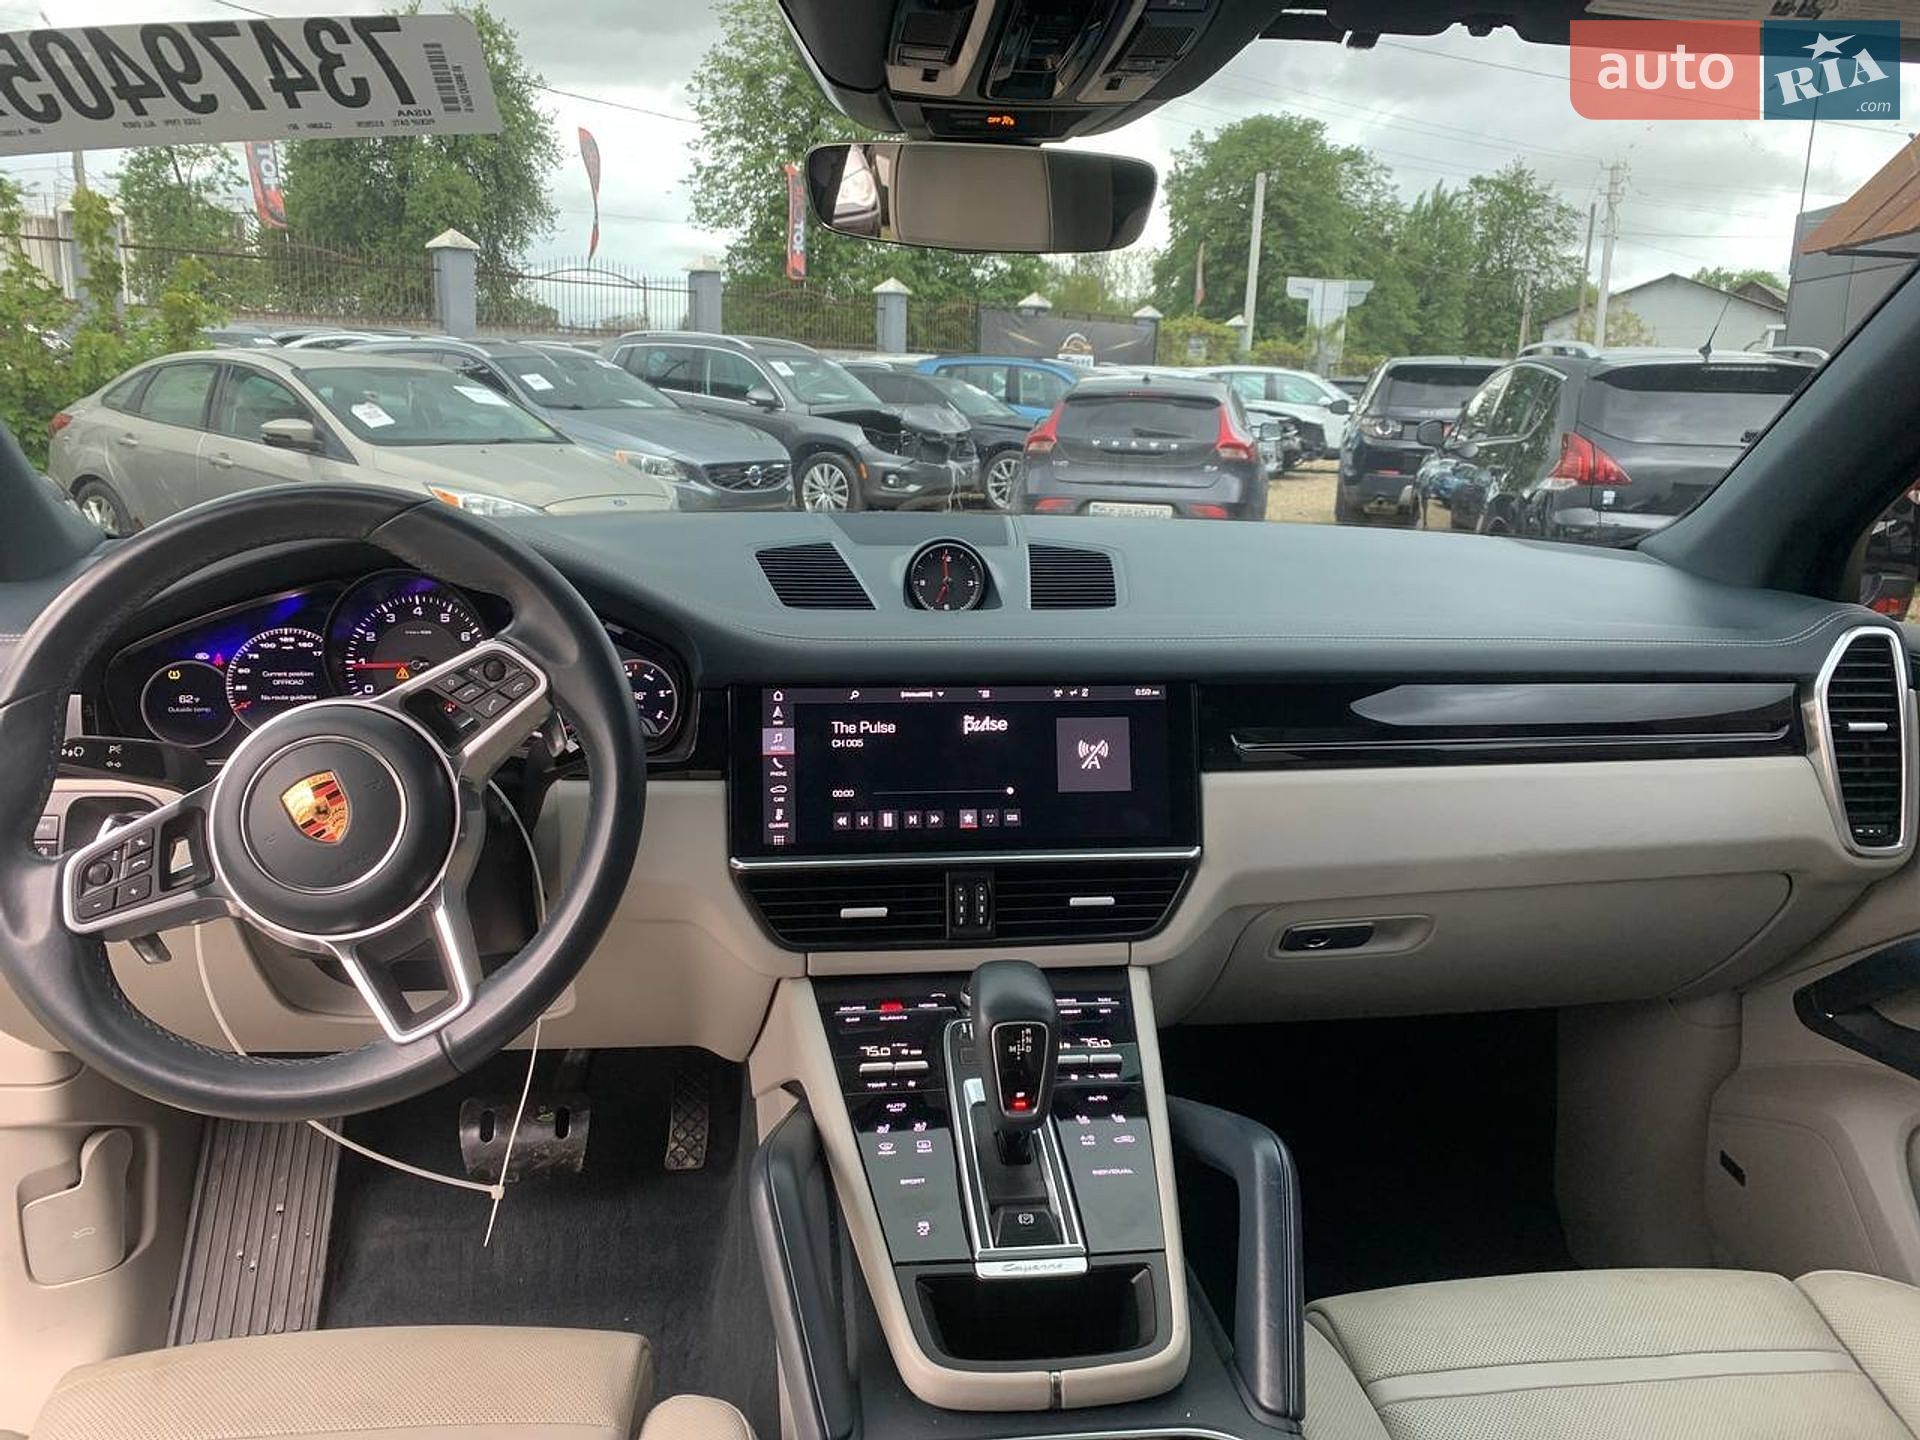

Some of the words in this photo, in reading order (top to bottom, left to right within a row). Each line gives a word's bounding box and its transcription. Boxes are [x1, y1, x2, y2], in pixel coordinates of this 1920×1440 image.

[413, 606, 423, 616] 4
[386, 613, 396, 623] 3
[440, 613, 450, 623] 5
[365, 631, 376, 642] 2
[460, 631, 471, 642] 6
[364, 684, 374, 694] 0
[178, 694, 194, 704] 62
[831, 720, 857, 734] The
[859, 720, 897, 735] Pulse
[831, 738, 845, 748] CH
[845, 738, 864, 748] 005
